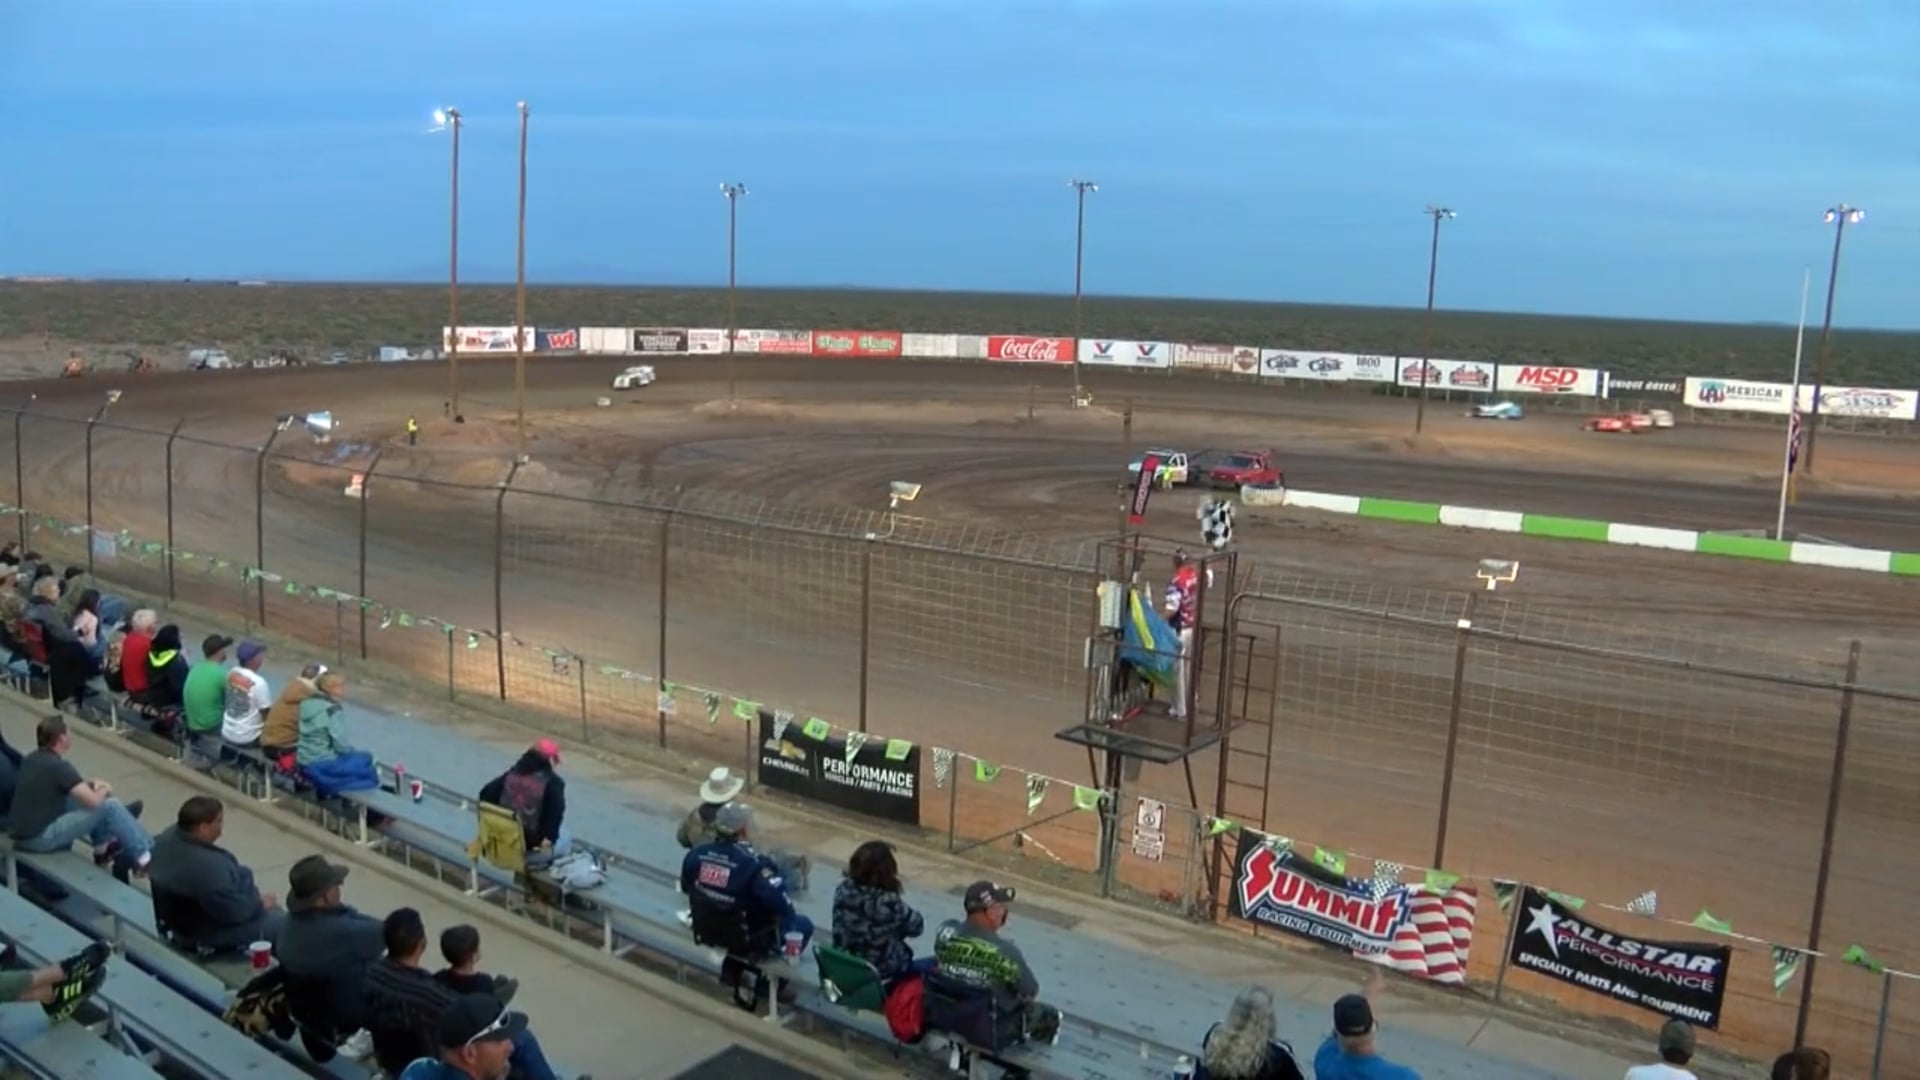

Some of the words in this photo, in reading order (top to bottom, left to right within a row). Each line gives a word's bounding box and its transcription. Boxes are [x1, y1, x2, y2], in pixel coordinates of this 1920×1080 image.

[1516, 367, 1579, 386] MSD
[859, 779, 880, 792] PARTS
[1257, 907, 1310, 933] RACING
[1309, 923, 1388, 955] EQUIPMENT
[1558, 918, 1719, 974] ALLSTAR
[1518, 952, 1574, 977] SPECIALTY
[1575, 970, 1611, 991] PARTS
[1612, 984, 1639, 999] AND
[1641, 995, 1713, 1023] EQUIPMENT
